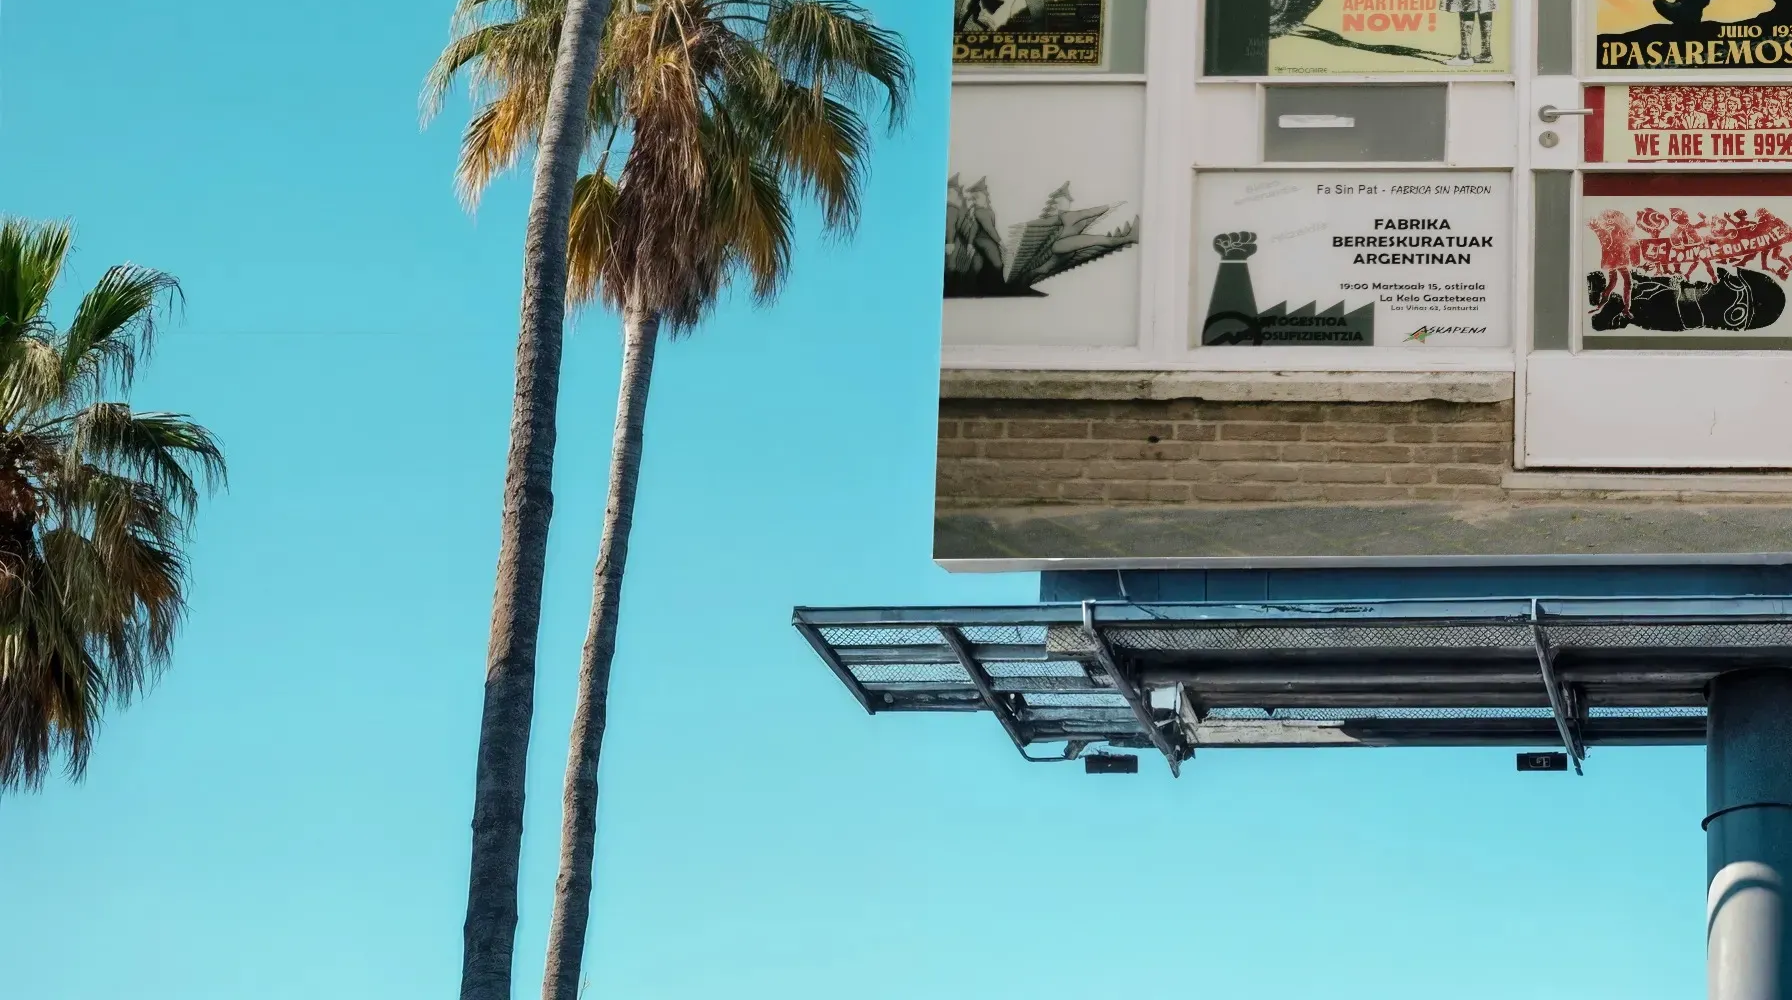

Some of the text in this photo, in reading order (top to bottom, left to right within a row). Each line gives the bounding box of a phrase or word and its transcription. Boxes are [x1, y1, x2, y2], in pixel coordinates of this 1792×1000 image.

[1342, 13, 1437, 32] NOW!
[1718, 25, 1762, 38] JULIO
[967, 35, 988, 43] OP
[993, 35, 1015, 43] DE
[1063, 35, 1094, 44] DER
[1634, 133, 1660, 156] WE
[1668, 134, 1703, 156] ARE
[1710, 133, 1745, 156] THE
[1316, 184, 1332, 195] Fa
[1334, 184, 1354, 195] Sin
[1358, 184, 1378, 195] Pat
[1390, 185, 1431, 195] FABRICA
[1434, 185, 1450, 195] SIN
[1453, 185, 1492, 195] PATRON
[1374, 218, 1451, 230] FABRIKA
[1332, 236, 1494, 248] BERRESKURATUAK
[1353, 253, 1471, 265] ARGENTINAN
[1372, 282, 1425, 290] Martxoak
[1444, 282, 1486, 290] ostirala
[1380, 294, 1486, 302] La Kelo Gaztetxean
